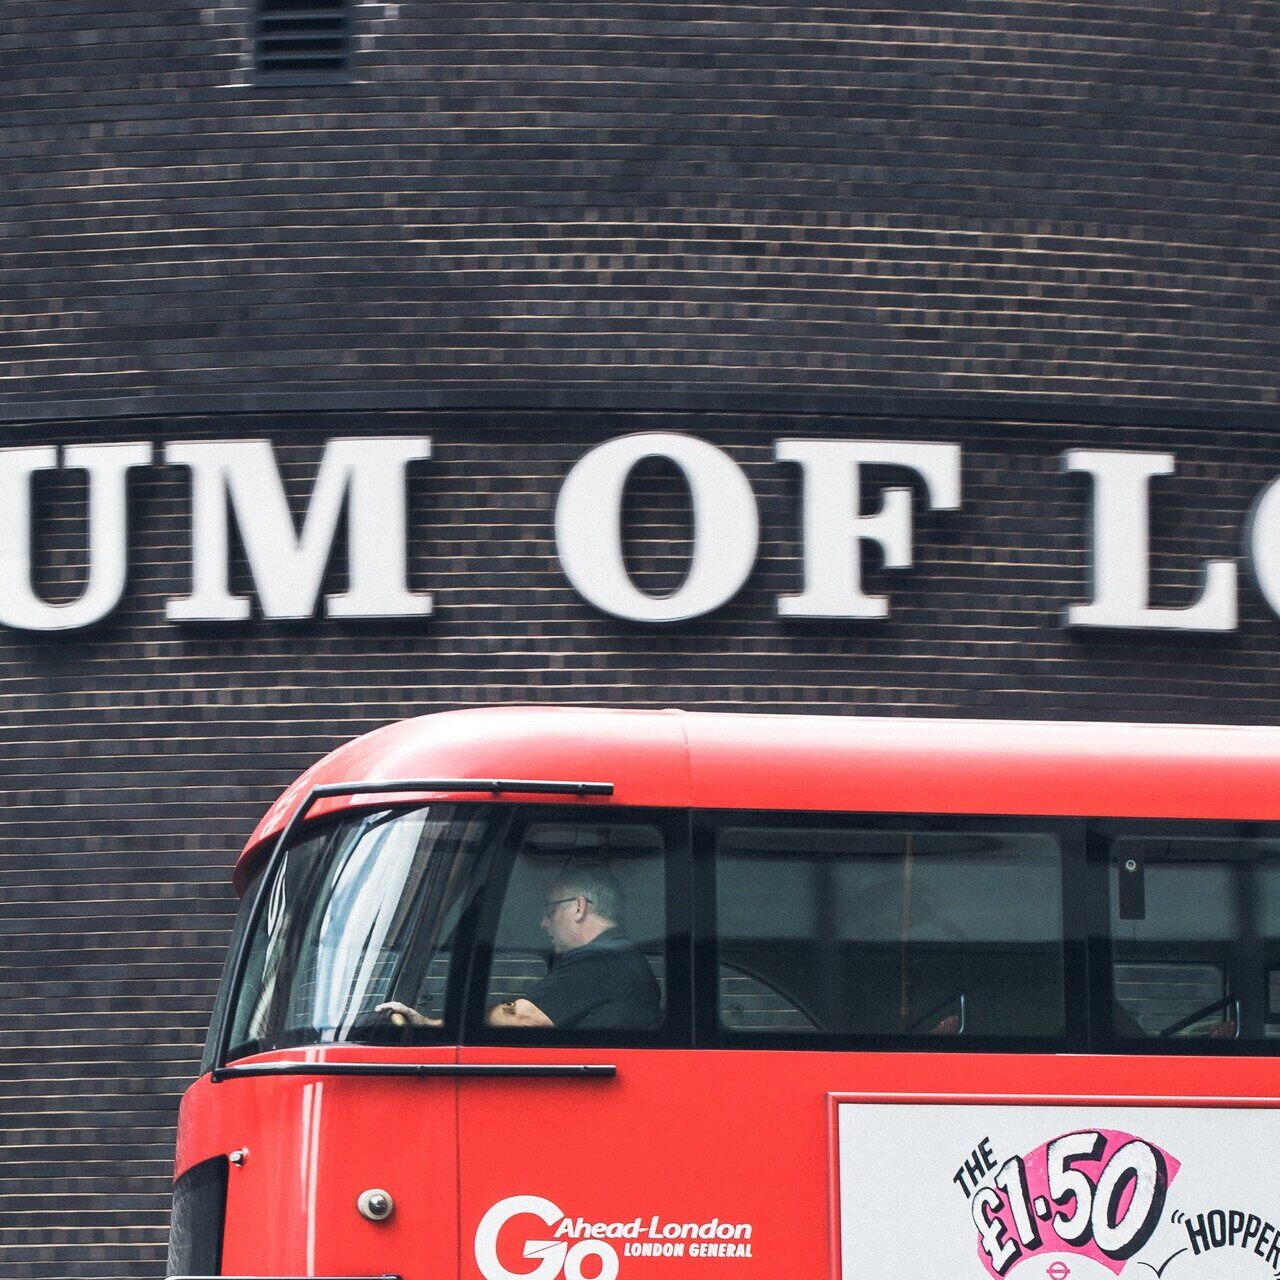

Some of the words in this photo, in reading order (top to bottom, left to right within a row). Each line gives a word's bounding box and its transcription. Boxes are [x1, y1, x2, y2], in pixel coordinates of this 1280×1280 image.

[553, 430, 962, 623] OF
[952, 1136, 999, 1200] THE
[553, 1215, 753, 1240] Ahead-London
[624, 1242, 685, 1258] LONDON
[688, 1242, 753, 1258] GENERAL
